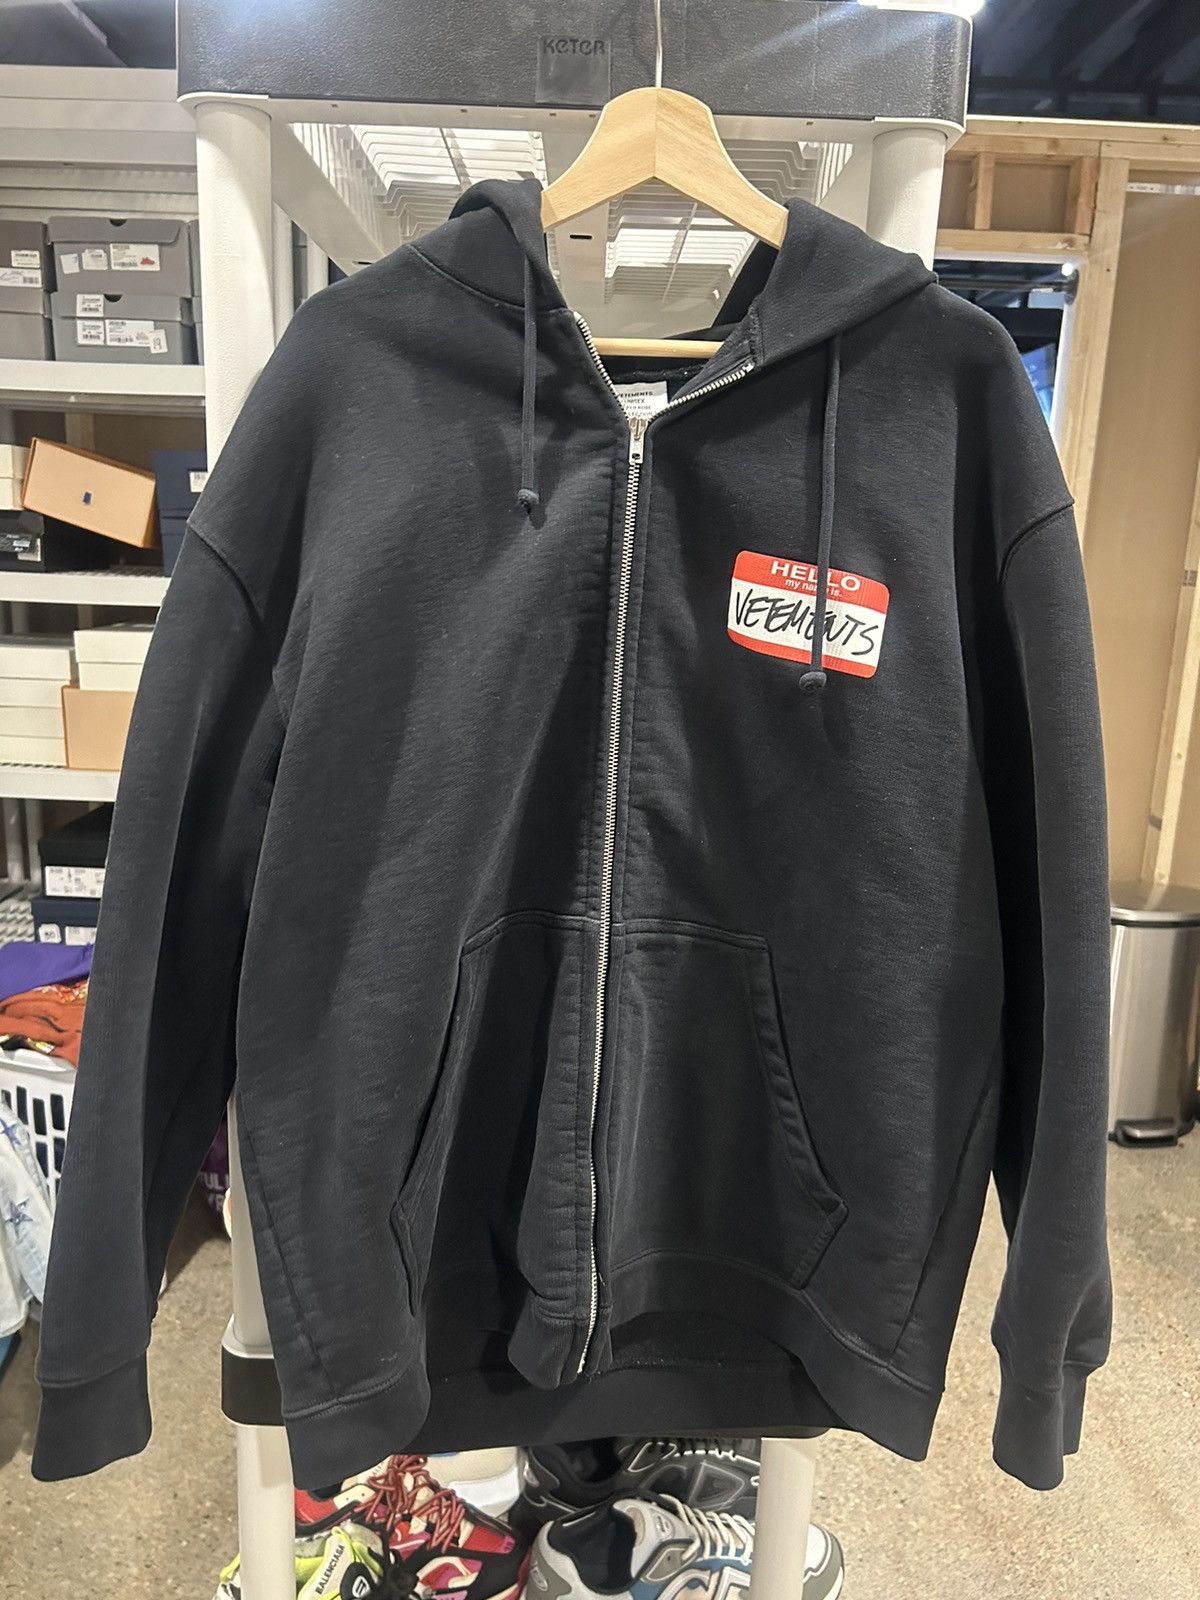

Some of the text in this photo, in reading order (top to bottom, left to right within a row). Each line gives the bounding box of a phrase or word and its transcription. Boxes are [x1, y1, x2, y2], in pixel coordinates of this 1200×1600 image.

[771, 560, 861, 592] HELLO
[785, 578, 801, 590] my
[802, 582, 829, 595] na
